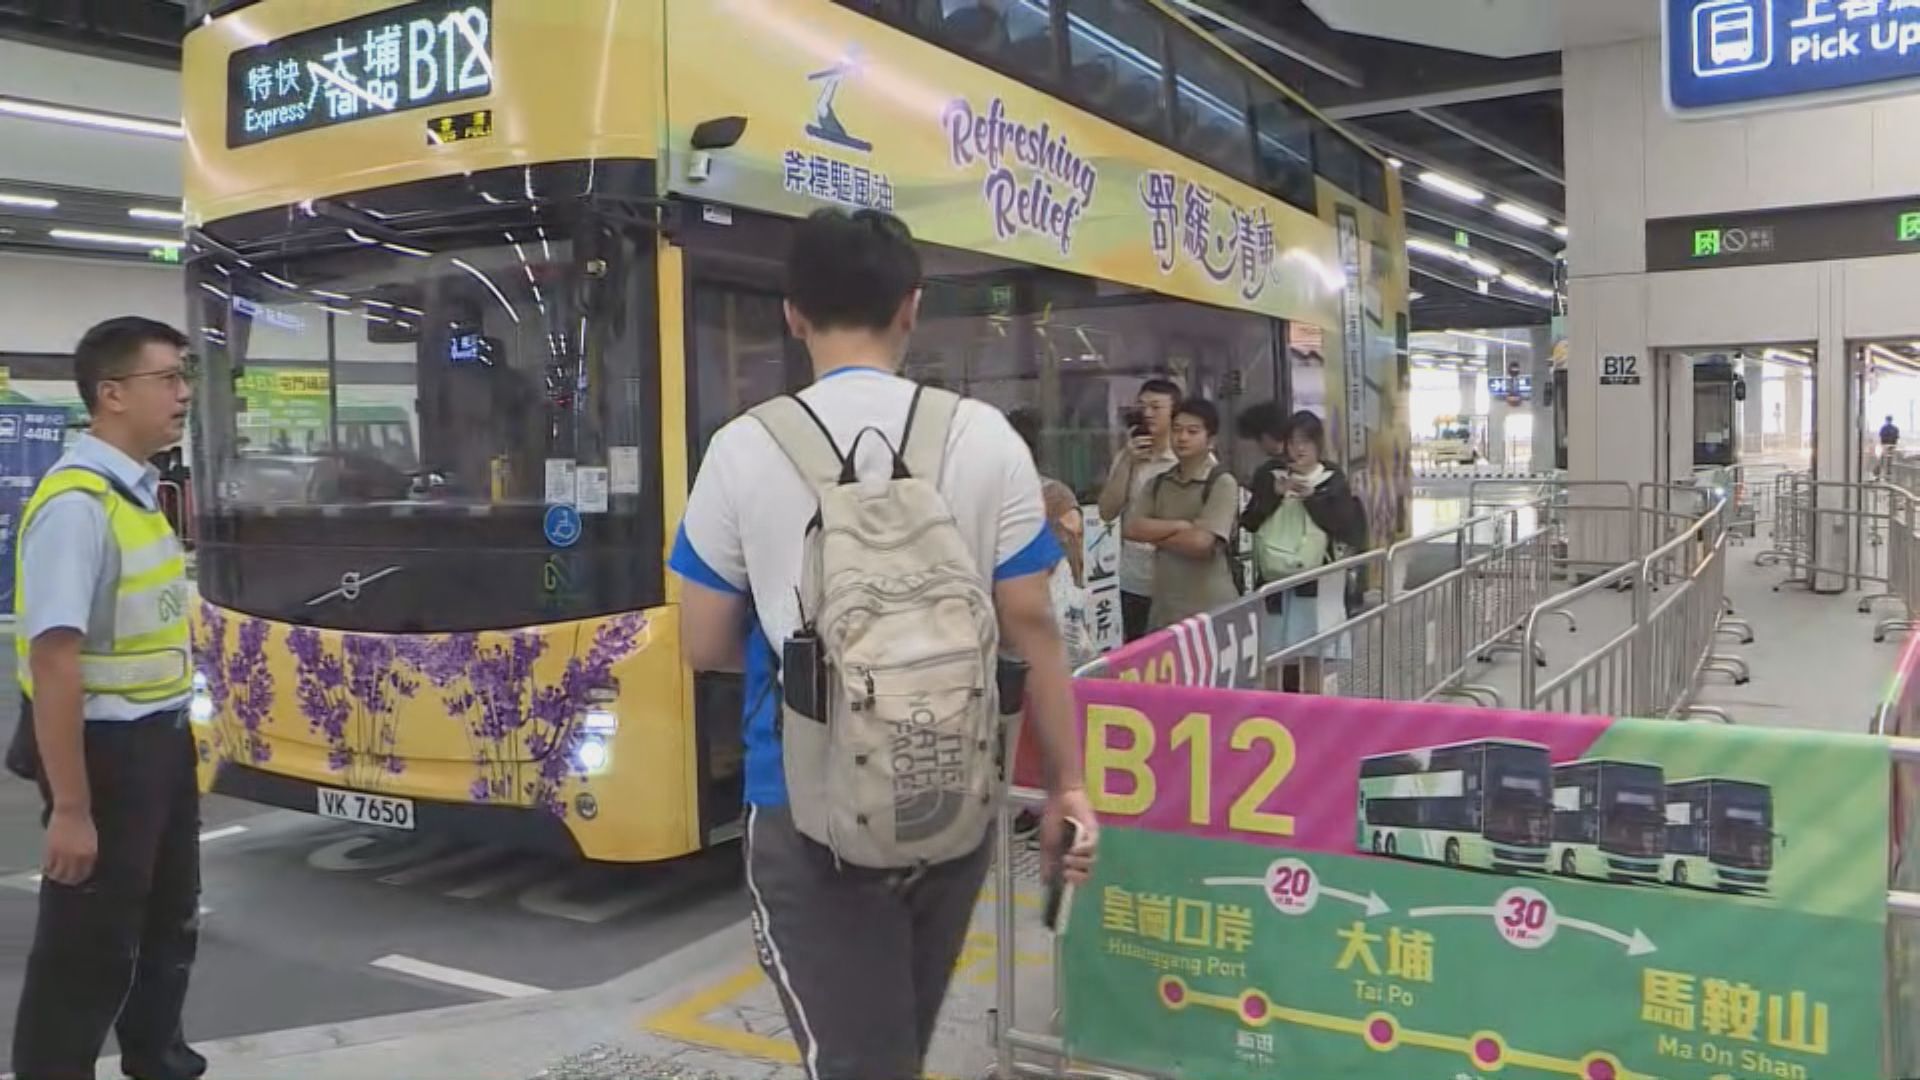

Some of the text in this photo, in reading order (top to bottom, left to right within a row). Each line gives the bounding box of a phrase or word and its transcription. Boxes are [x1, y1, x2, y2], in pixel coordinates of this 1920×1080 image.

[322, 24, 402, 88] 大埔
[409, 6, 489, 100] B12
[1791, 20, 1920, 65] Pick Up
[248, 58, 301, 102] 特快
[325, 84, 358, 118] Tai
[245, 100, 306, 134] Express
[943, 97, 1096, 199] Refreshing
[784, 150, 893, 212] 斧標驅風油
[986, 169, 1081, 255] Relief
[1605, 355, 1637, 375] B12
[939, 733, 965, 786] THE
[1085, 704, 1297, 836] B12
[322, 791, 409, 825] VK 7650
[1272, 866, 1311, 897] 20
[1103, 886, 1254, 953] 皇崗口岸
[1503, 896, 1548, 929] 30
[1206, 953, 1248, 978] Port
[1335, 920, 1435, 983] 大埔
[1355, 979, 1414, 1008] Tai Po
[1641, 967, 1829, 1055] 馬鞍山
[1658, 1034, 1807, 1080] Ma On Shan
